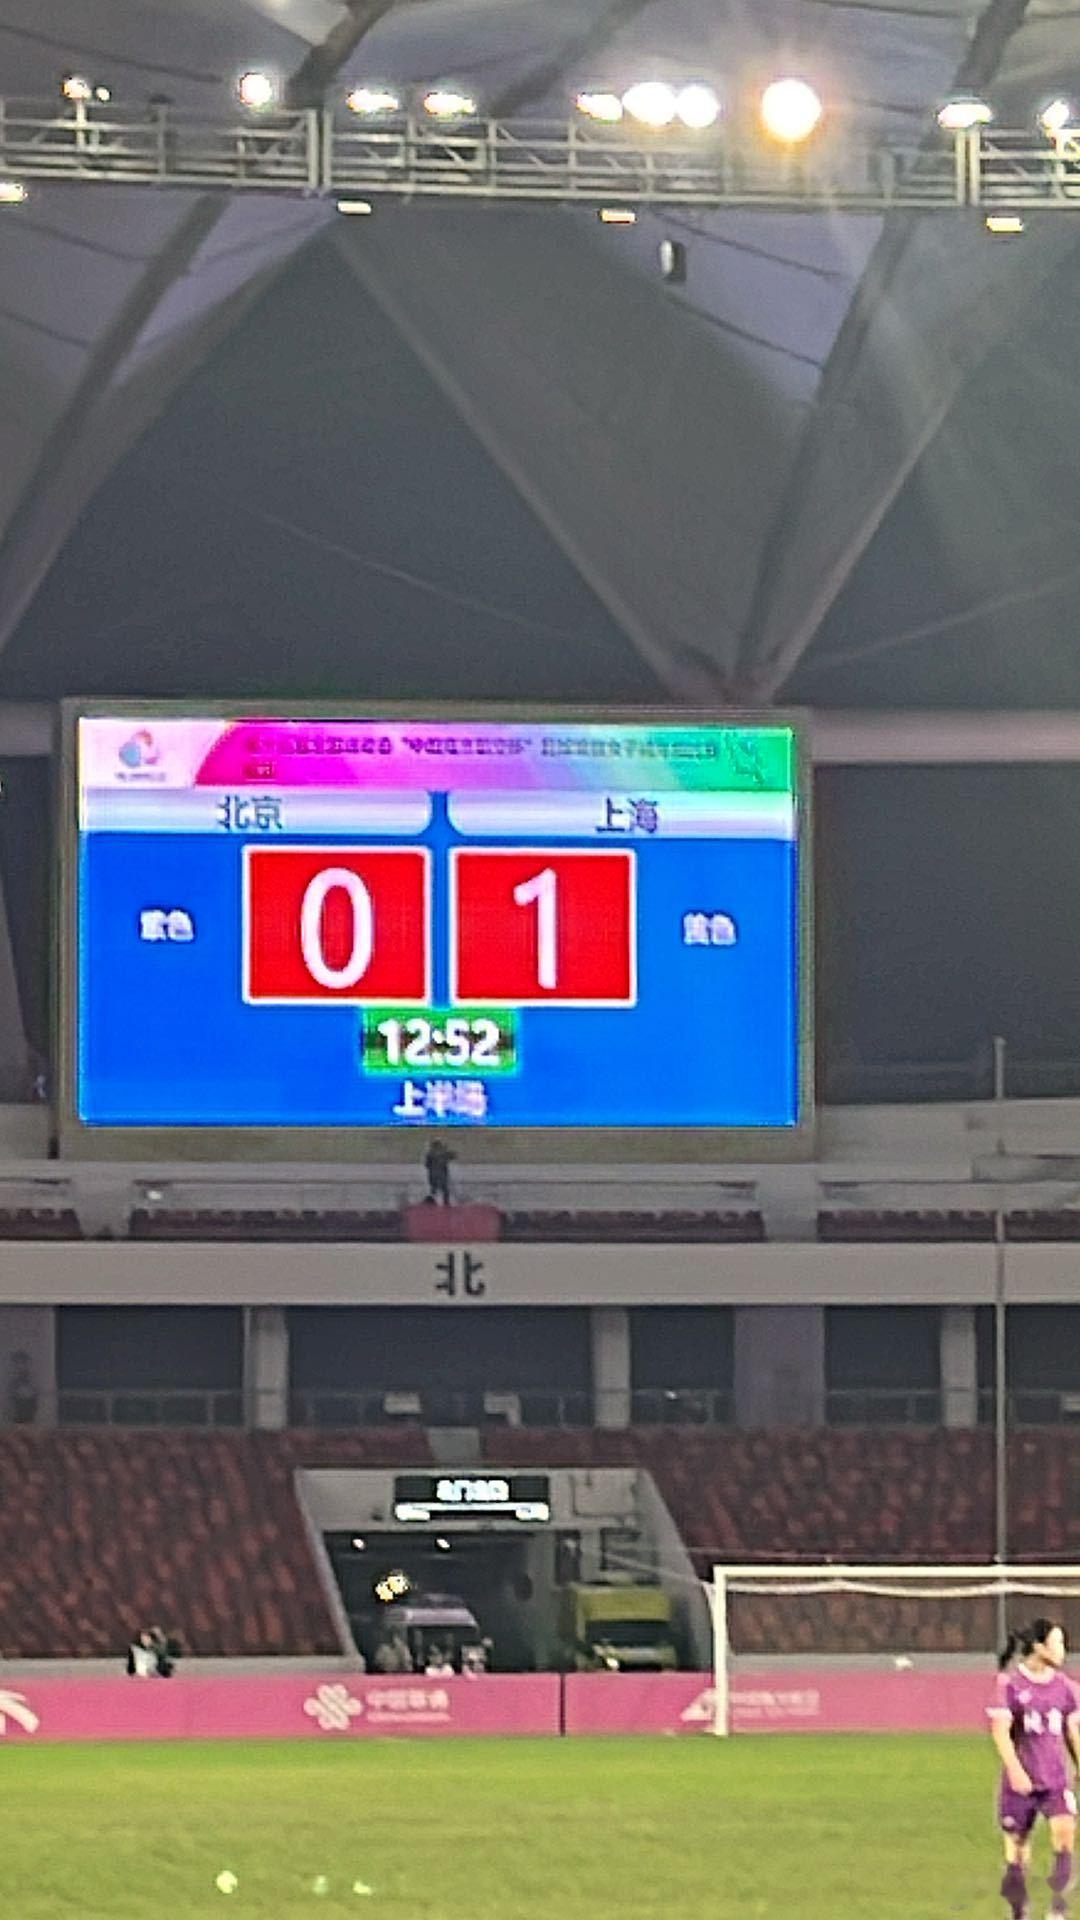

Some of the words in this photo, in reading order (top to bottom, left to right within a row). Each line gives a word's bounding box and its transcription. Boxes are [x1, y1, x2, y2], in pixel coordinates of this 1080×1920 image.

[217, 795, 283, 830] 北京
[596, 797, 658, 834] 上海
[300, 867, 373, 989] 0
[513, 868, 557, 989] 1
[377, 1018, 500, 1066] 12:52
[435, 1252, 486, 1296] 北
